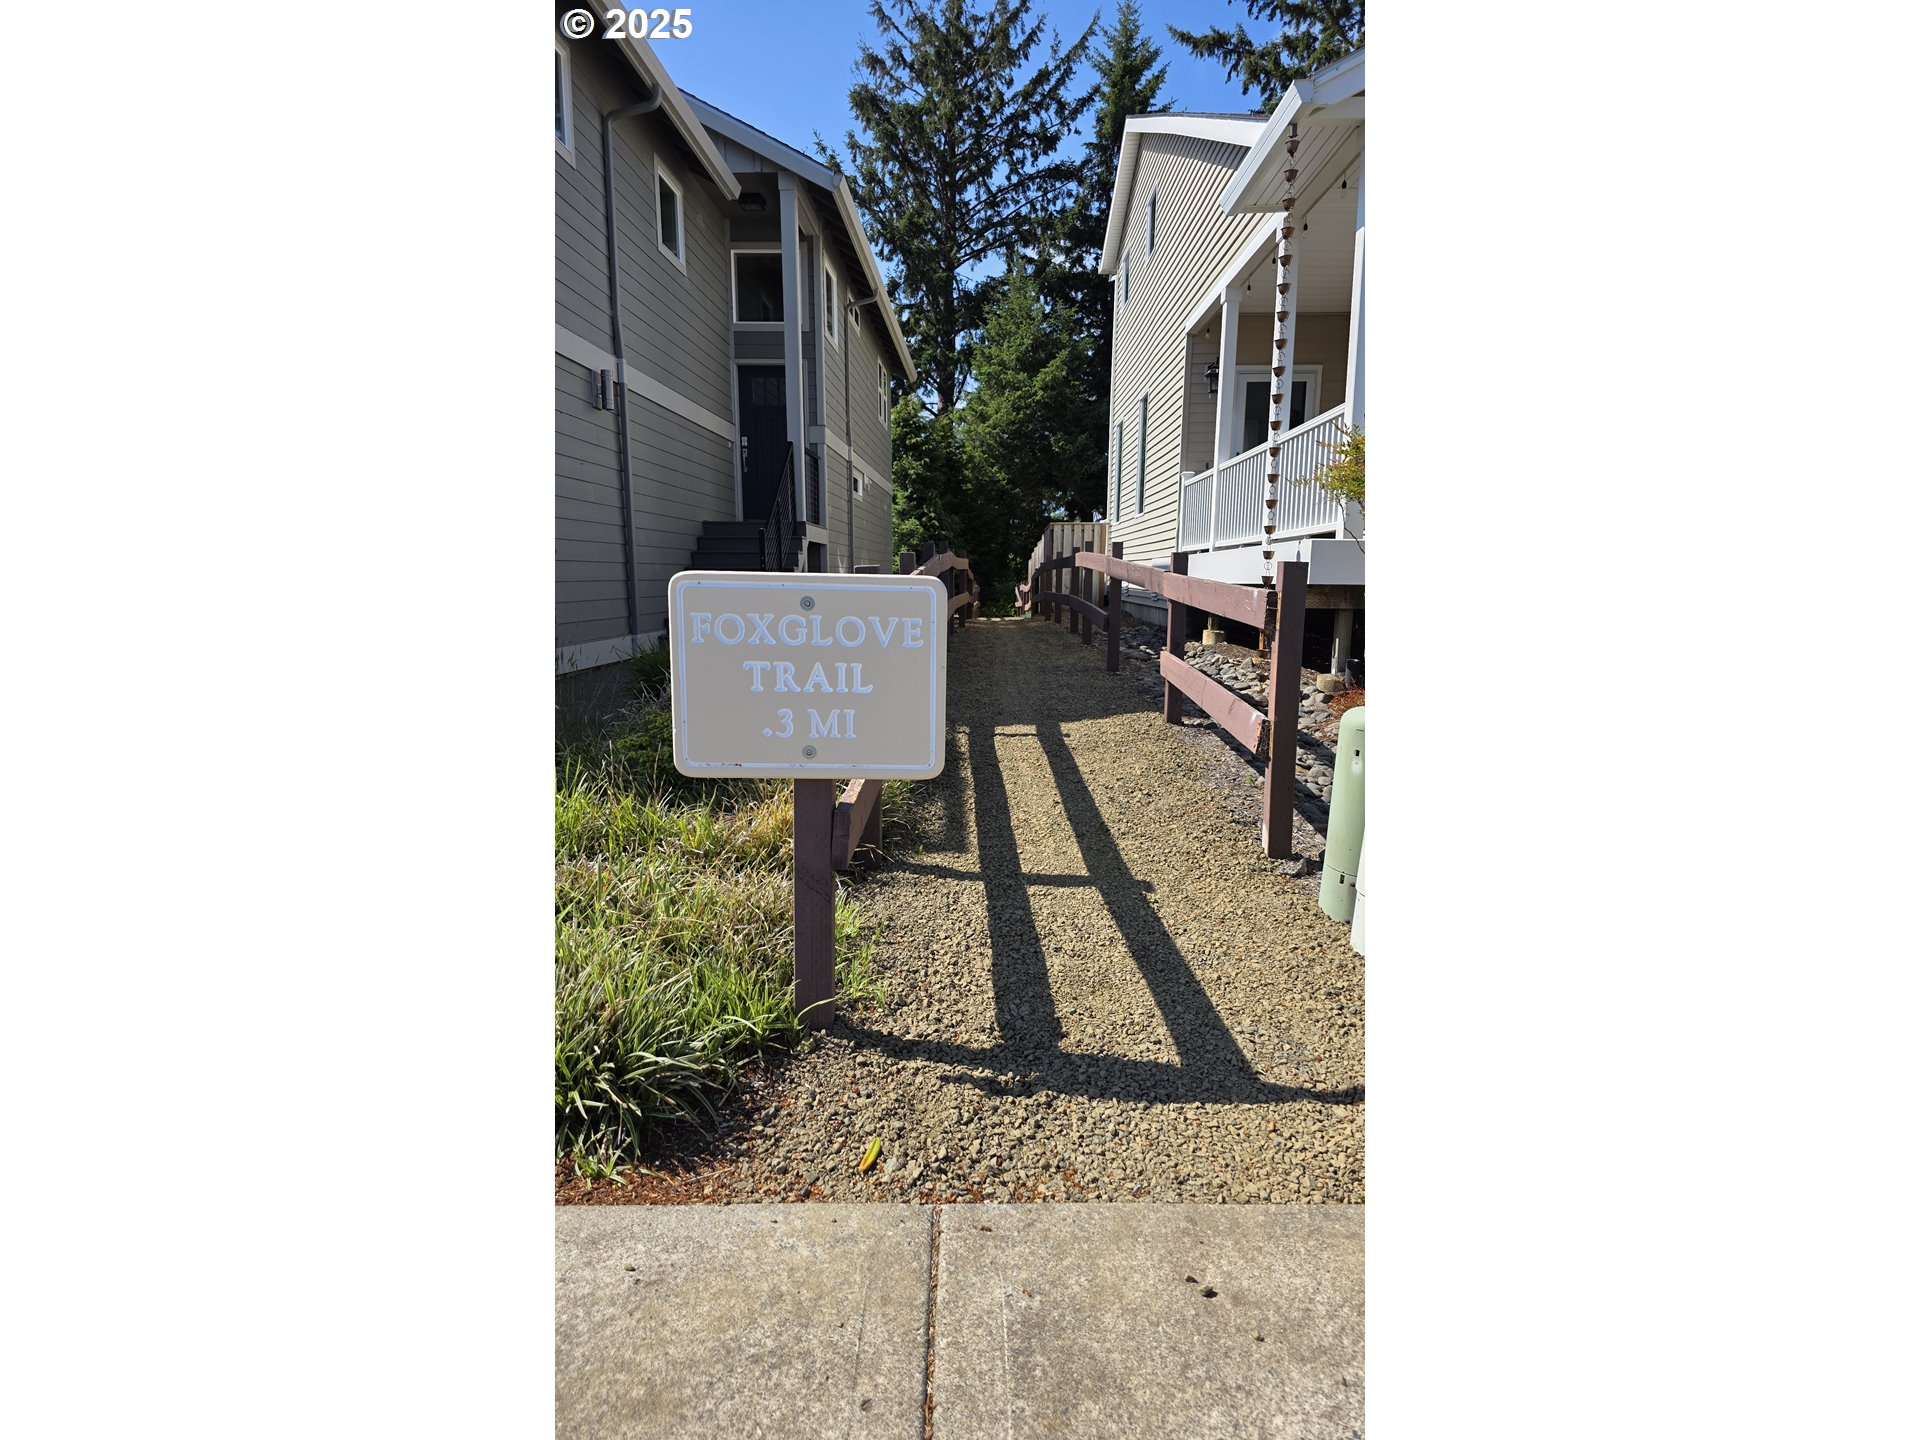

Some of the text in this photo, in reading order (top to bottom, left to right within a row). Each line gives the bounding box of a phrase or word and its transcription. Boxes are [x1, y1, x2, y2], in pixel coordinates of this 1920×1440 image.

[689, 612, 924, 648] FOXGLOVE
[743, 660, 874, 694] TRAIL
[762, 707, 857, 739] .3 MI
